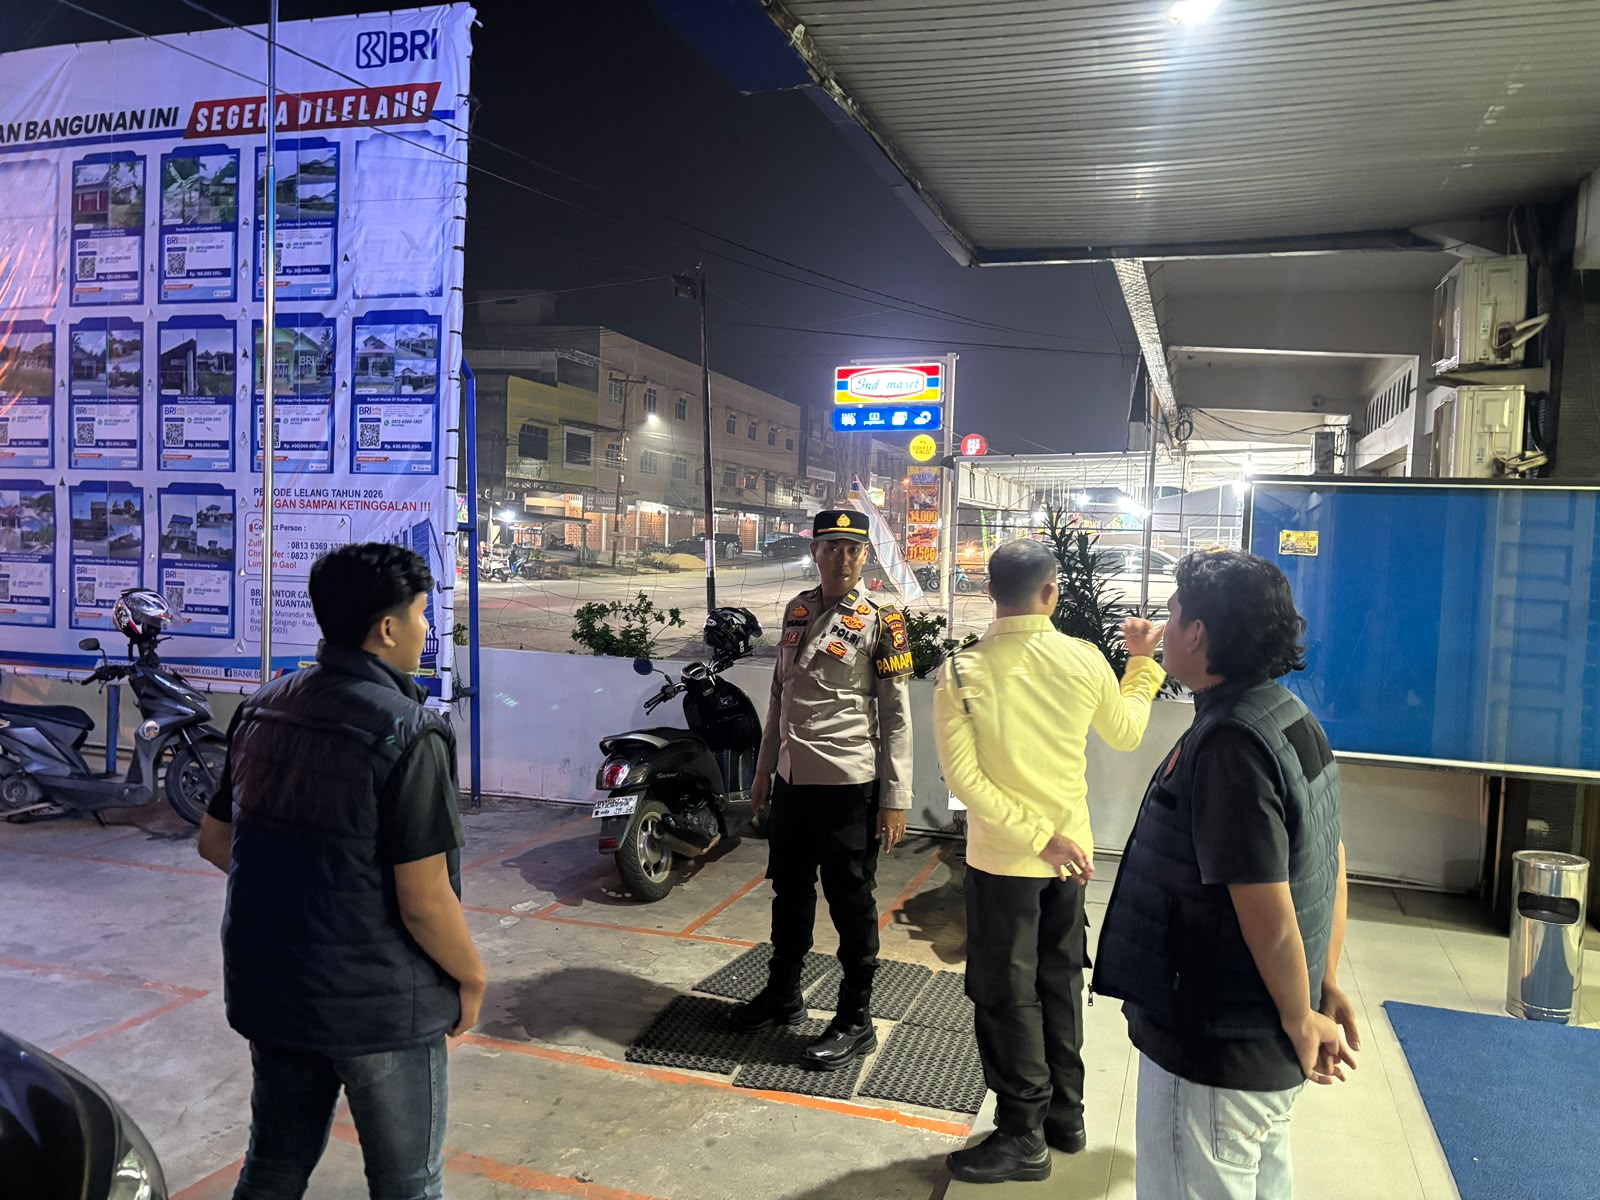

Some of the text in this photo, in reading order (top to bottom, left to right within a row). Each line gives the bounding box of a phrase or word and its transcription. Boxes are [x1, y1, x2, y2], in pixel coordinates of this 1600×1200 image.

[389, 28, 437, 63] BRI
[25, 109, 146, 141] BANGUNAN
[148, 106, 179, 128] INI
[298, 90, 428, 125] DILELANG
[165, 407, 176, 415] BRI
[359, 407, 371, 415] BRI
[254, 488, 383, 498] PEODE LELANG TAHUN 2026
[254, 499, 431, 512] JAGAN SAMPAI KETINGGALAN !!!
[254, 523, 278, 531] Coct
[291, 541, 308, 549] 0813
[310, 542, 327, 550] 6369
[166, 570, 176, 579] BRI
[250, 588, 261, 597] BR
[275, 599, 311, 608] KUANTAN
[830, 625, 862, 646] POLRI
[174, 667, 218, 676] www.bri.co.id
[233, 670, 252, 678] BANK
